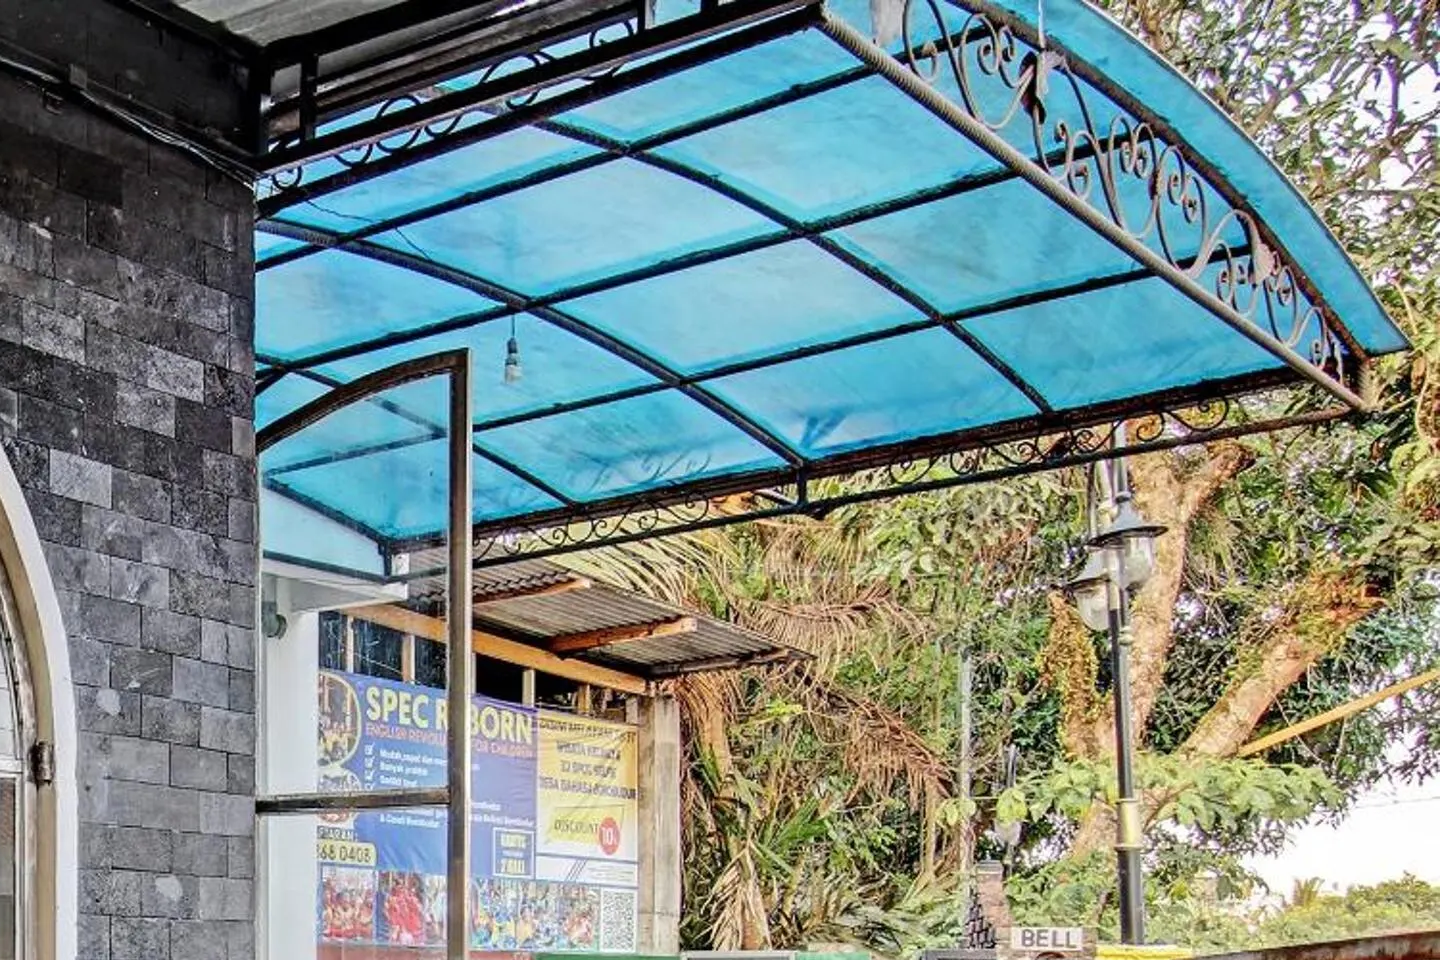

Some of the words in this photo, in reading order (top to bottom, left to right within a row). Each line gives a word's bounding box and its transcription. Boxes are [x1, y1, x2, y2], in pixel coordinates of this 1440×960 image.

[366, 686, 429, 729] SPEC
[435, 698, 532, 745] RBORN
[553, 819, 599, 833] DISCOUNT
[1020, 929, 1077, 949] BELL
